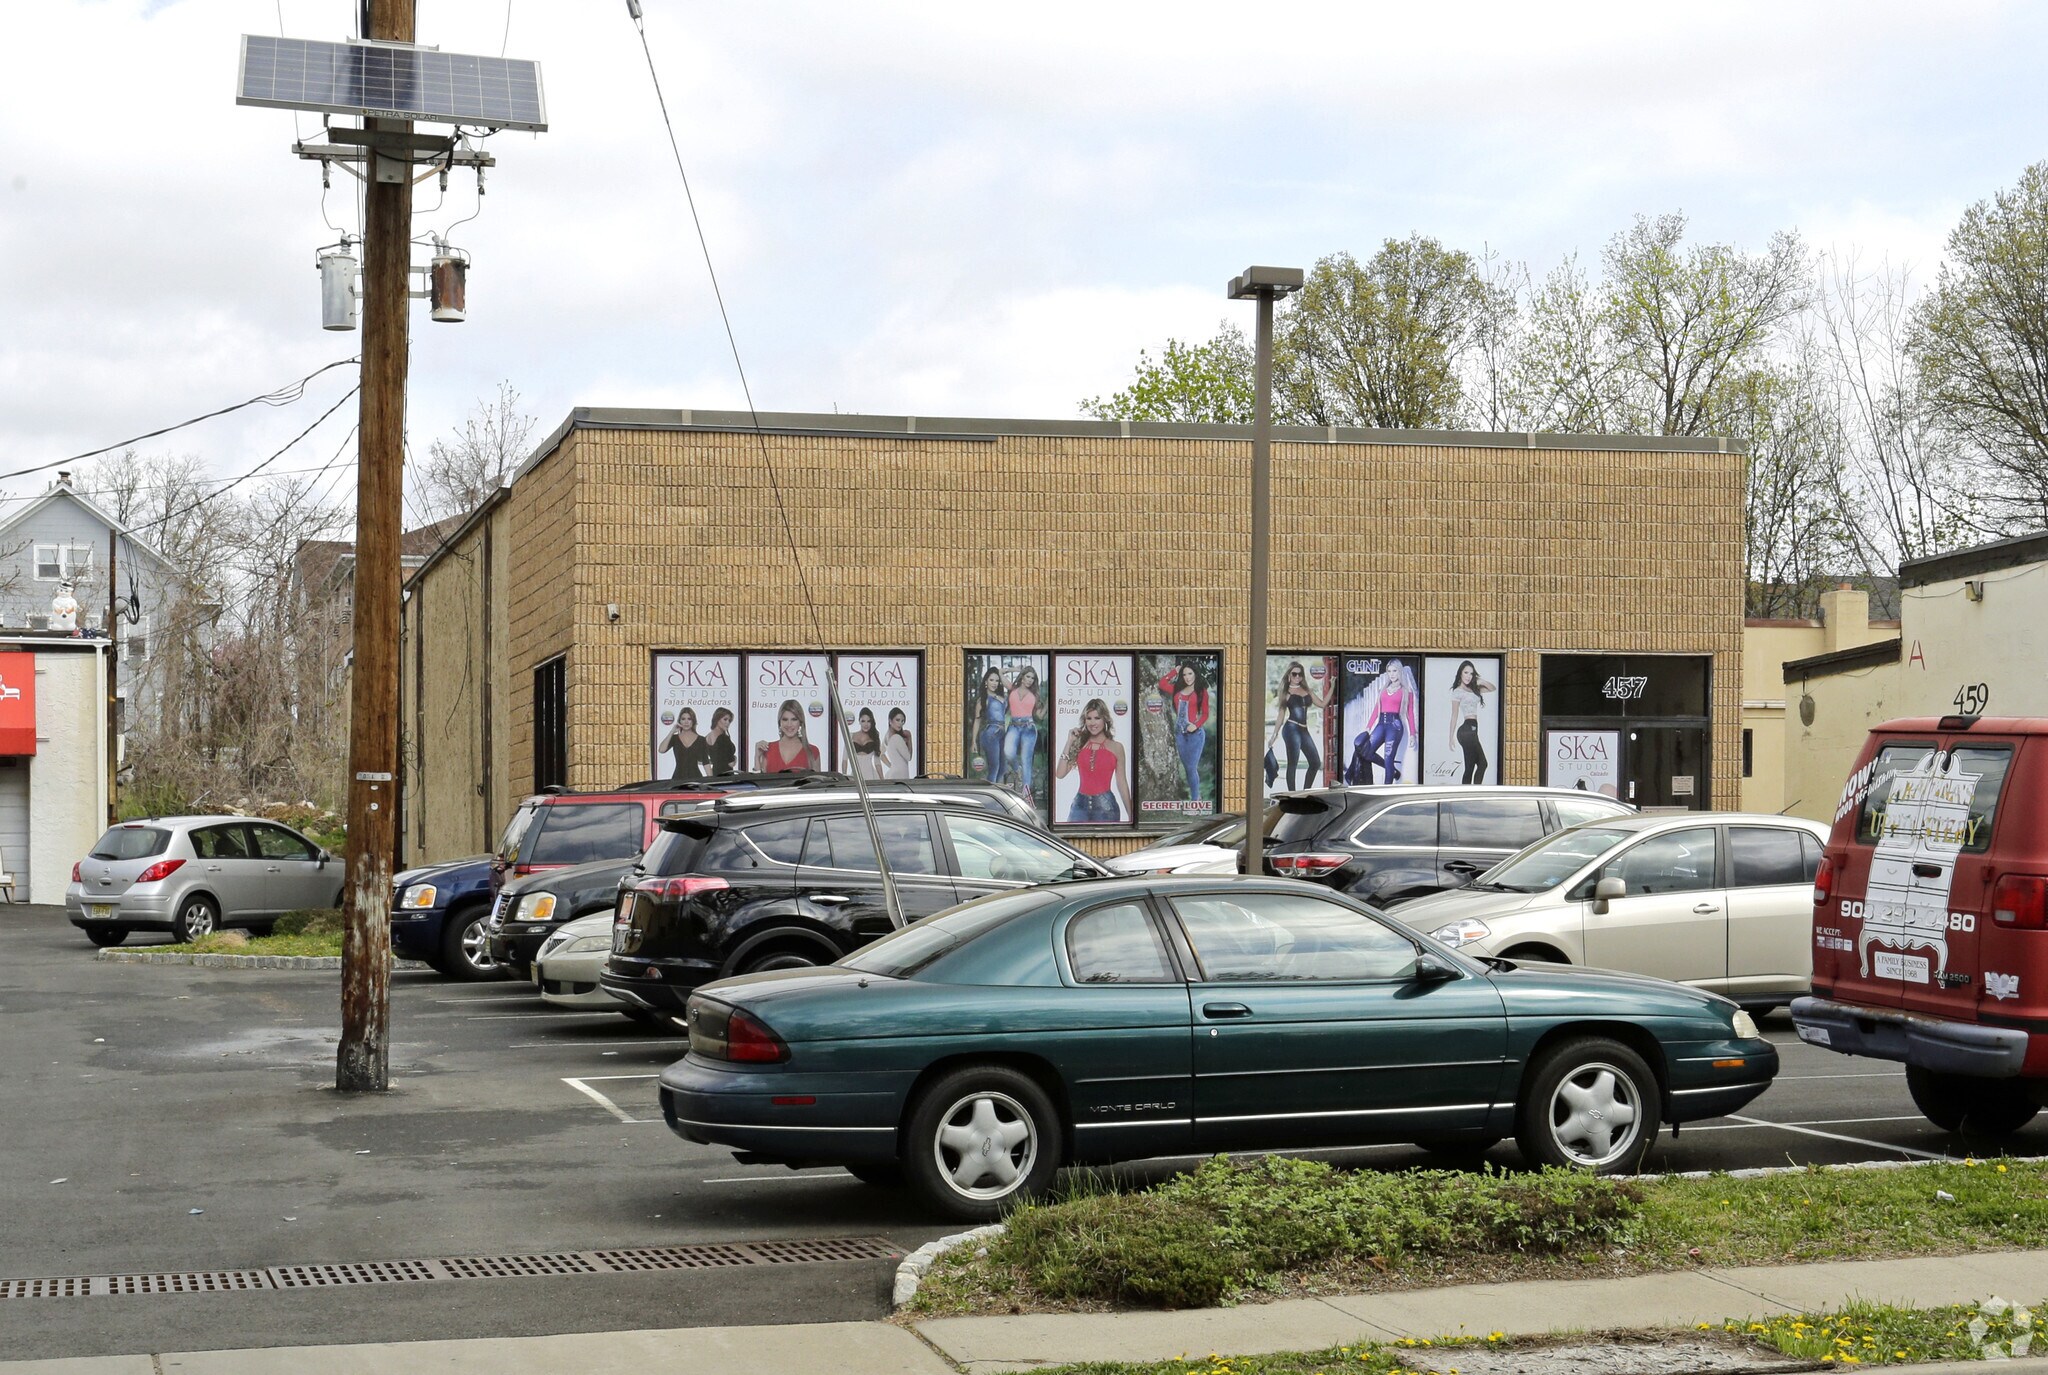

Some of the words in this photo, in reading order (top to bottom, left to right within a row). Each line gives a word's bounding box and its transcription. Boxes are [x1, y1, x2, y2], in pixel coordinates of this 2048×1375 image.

[367, 108, 400, 118] PETRA
[403, 111, 438, 121] SOLAR
[667, 660, 729, 687] SKA
[759, 660, 819, 686] SKA
[848, 661, 907, 687] SKA
[1065, 659, 1122, 686] SKA
[1067, 688, 1121, 697] STUDIO
[1601, 676, 1648, 699] 457
[669, 690, 728, 698] STUDIO
[761, 689, 818, 698] STUDIO
[850, 690, 906, 699] STUDIO
[1953, 682, 1989, 716] 459
[663, 698, 685, 707] Fajas
[686, 698, 732, 706] Reductoras
[751, 701, 778, 709] Blusas
[844, 698, 865, 707] Fajas
[867, 698, 910, 706] Reductoras
[1057, 698, 1081, 706] Bodys
[1058, 707, 1080, 715] Blusa
[1557, 735, 1609, 760] SKA
[1558, 762, 1608, 771] STUDIO
[1142, 800, 1181, 810] SECRET
[1183, 800, 1213, 810] LOVE
[1881, 956, 1900, 966] FAMILY
[1900, 958, 1927, 969] BUSINESS
[1886, 966, 1903, 977] SINCE
[1949, 973, 1970, 984] 2500
[1090, 1104, 1132, 1113] MONTE
[1134, 1101, 1176, 1111] CARLO
